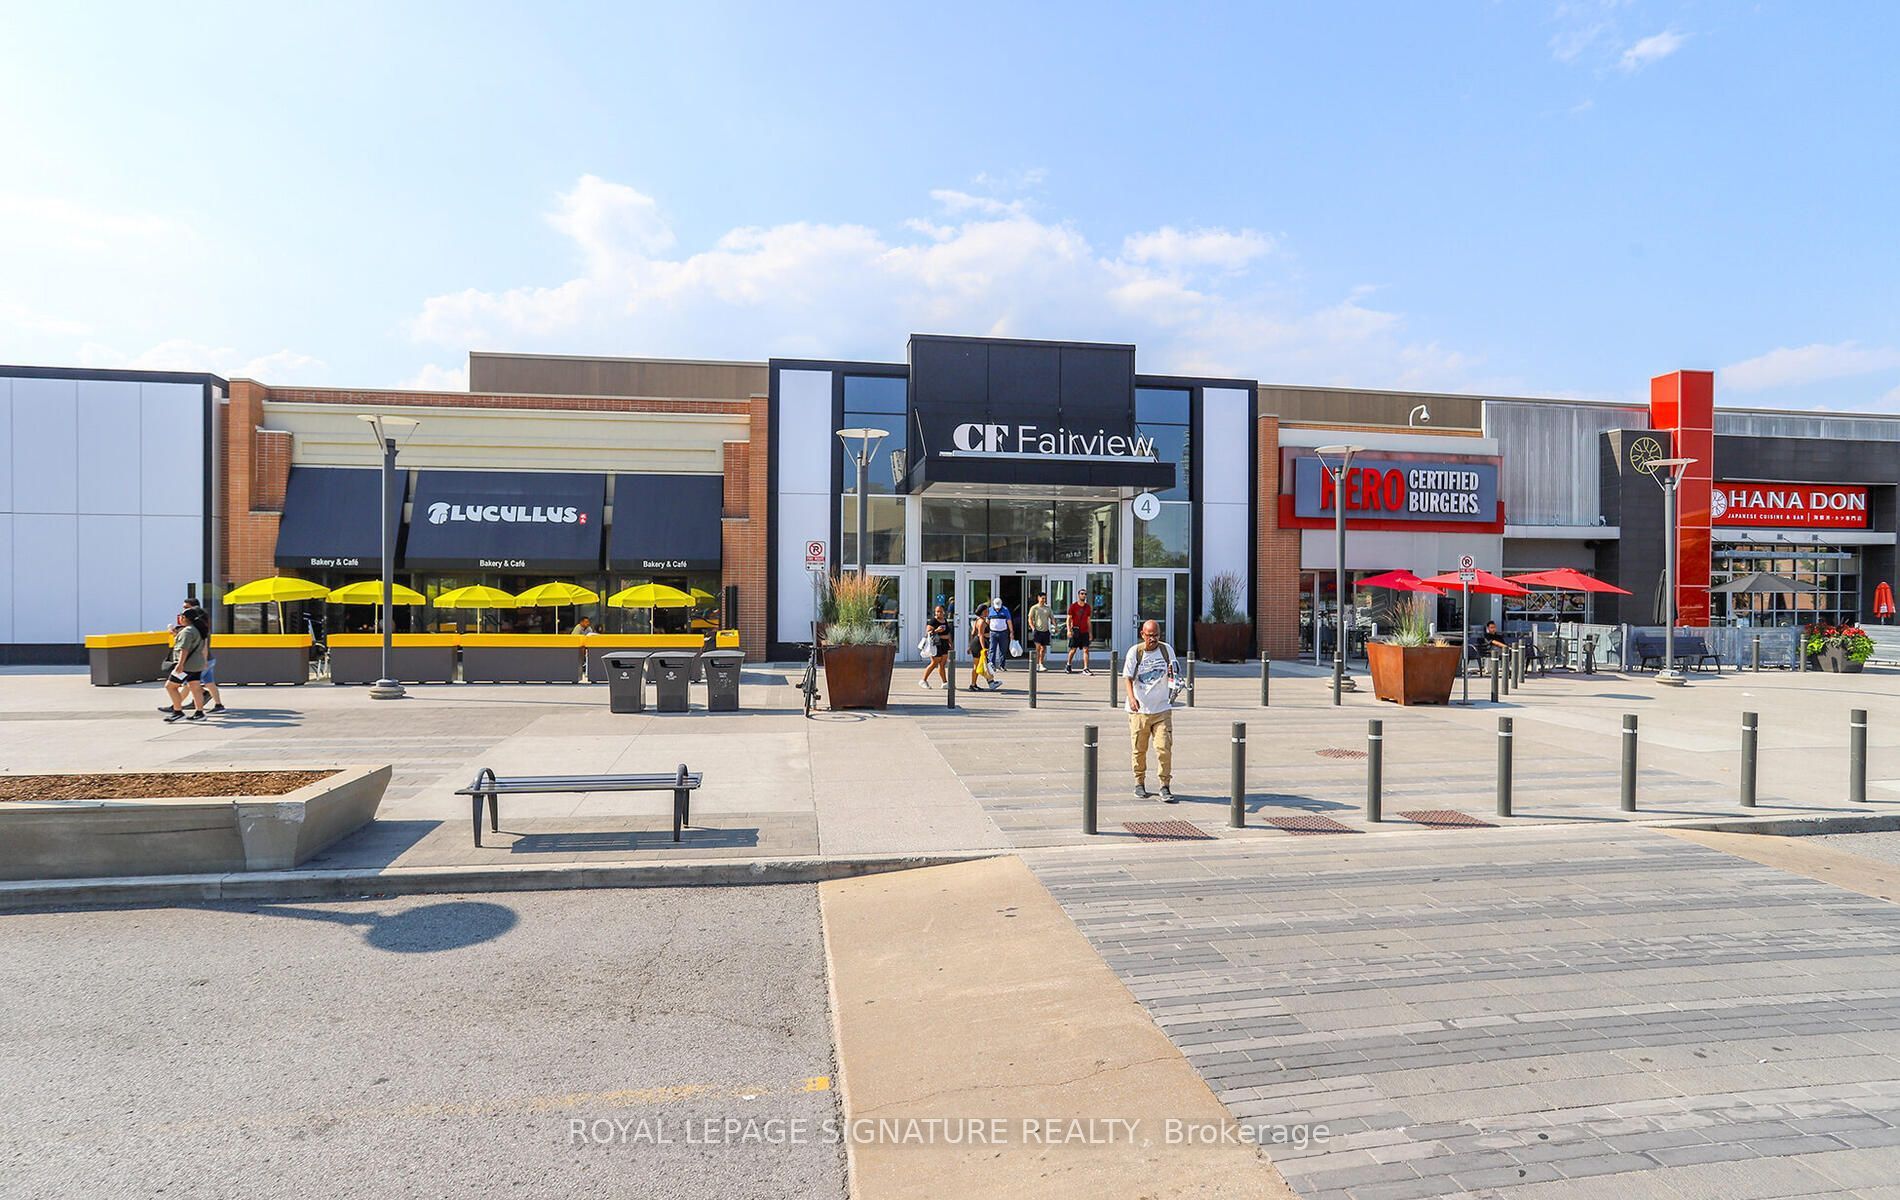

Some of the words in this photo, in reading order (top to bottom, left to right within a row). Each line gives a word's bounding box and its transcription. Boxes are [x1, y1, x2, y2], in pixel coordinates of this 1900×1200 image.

[953, 423, 1009, 452] CF
[1018, 425, 1154, 457] Fairview
[1320, 465, 1406, 512] HERO
[1408, 469, 1479, 491] CERTIFIED
[1140, 499, 1152, 514] 4
[1408, 491, 1479, 514] BURGERS
[1729, 490, 1804, 509] HANA
[1809, 492, 1865, 511] DON
[450, 504, 578, 523] LUCULLUS
[310, 558, 335, 568] Bakery
[336, 558, 342, 566] &
[343, 558, 359, 566] Café
[480, 560, 503, 569] Bakery
[510, 560, 526, 568] Café
[643, 560, 666, 569] Bakery
[666, 560, 672, 568] &
[672, 560, 688, 568] Café
